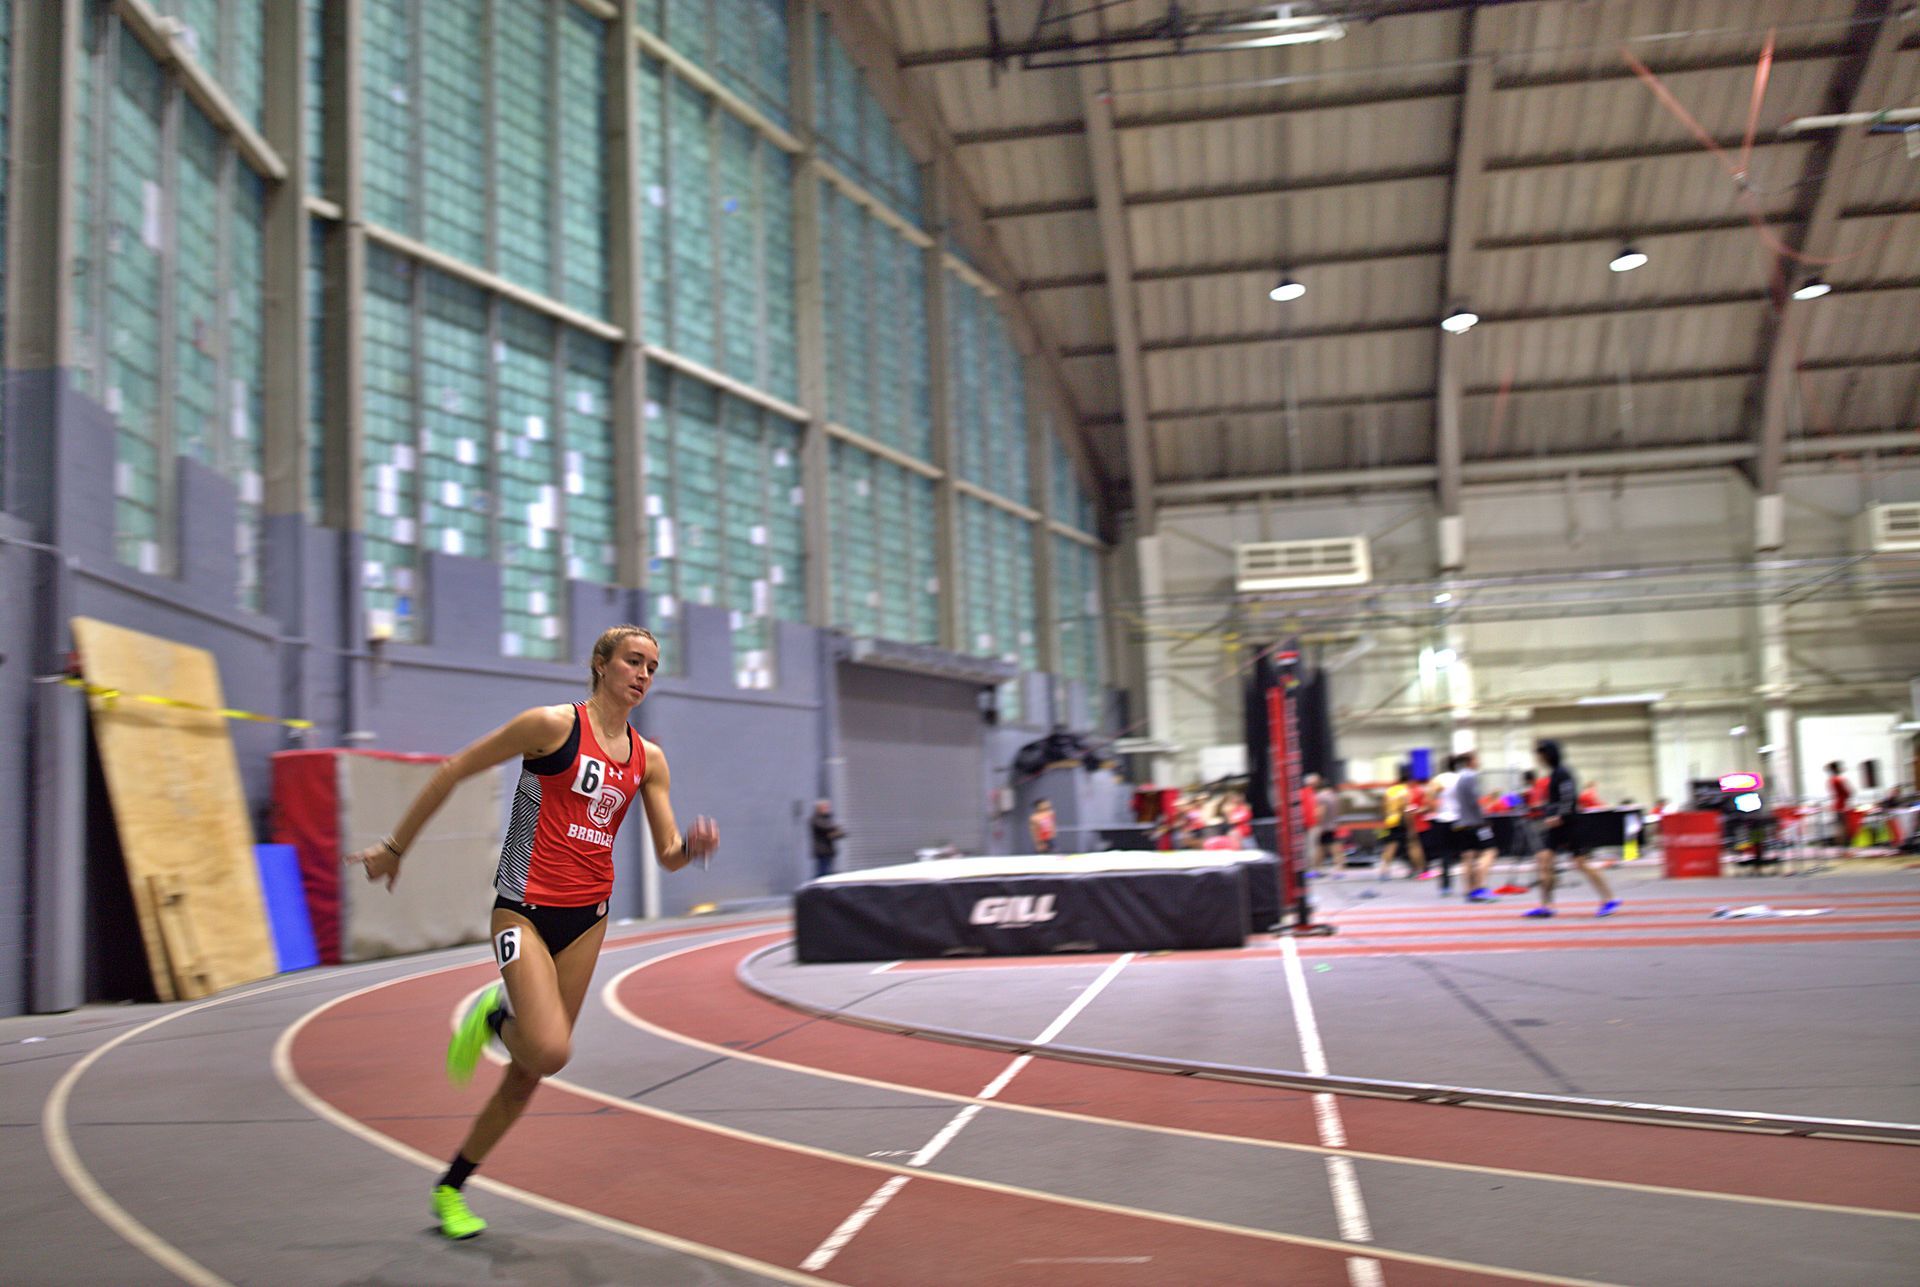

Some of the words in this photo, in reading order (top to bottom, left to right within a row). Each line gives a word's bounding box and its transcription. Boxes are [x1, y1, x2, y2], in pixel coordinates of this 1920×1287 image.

[581, 760, 600, 794] 6
[970, 893, 1058, 924] GILL
[500, 930, 516, 963] 6
